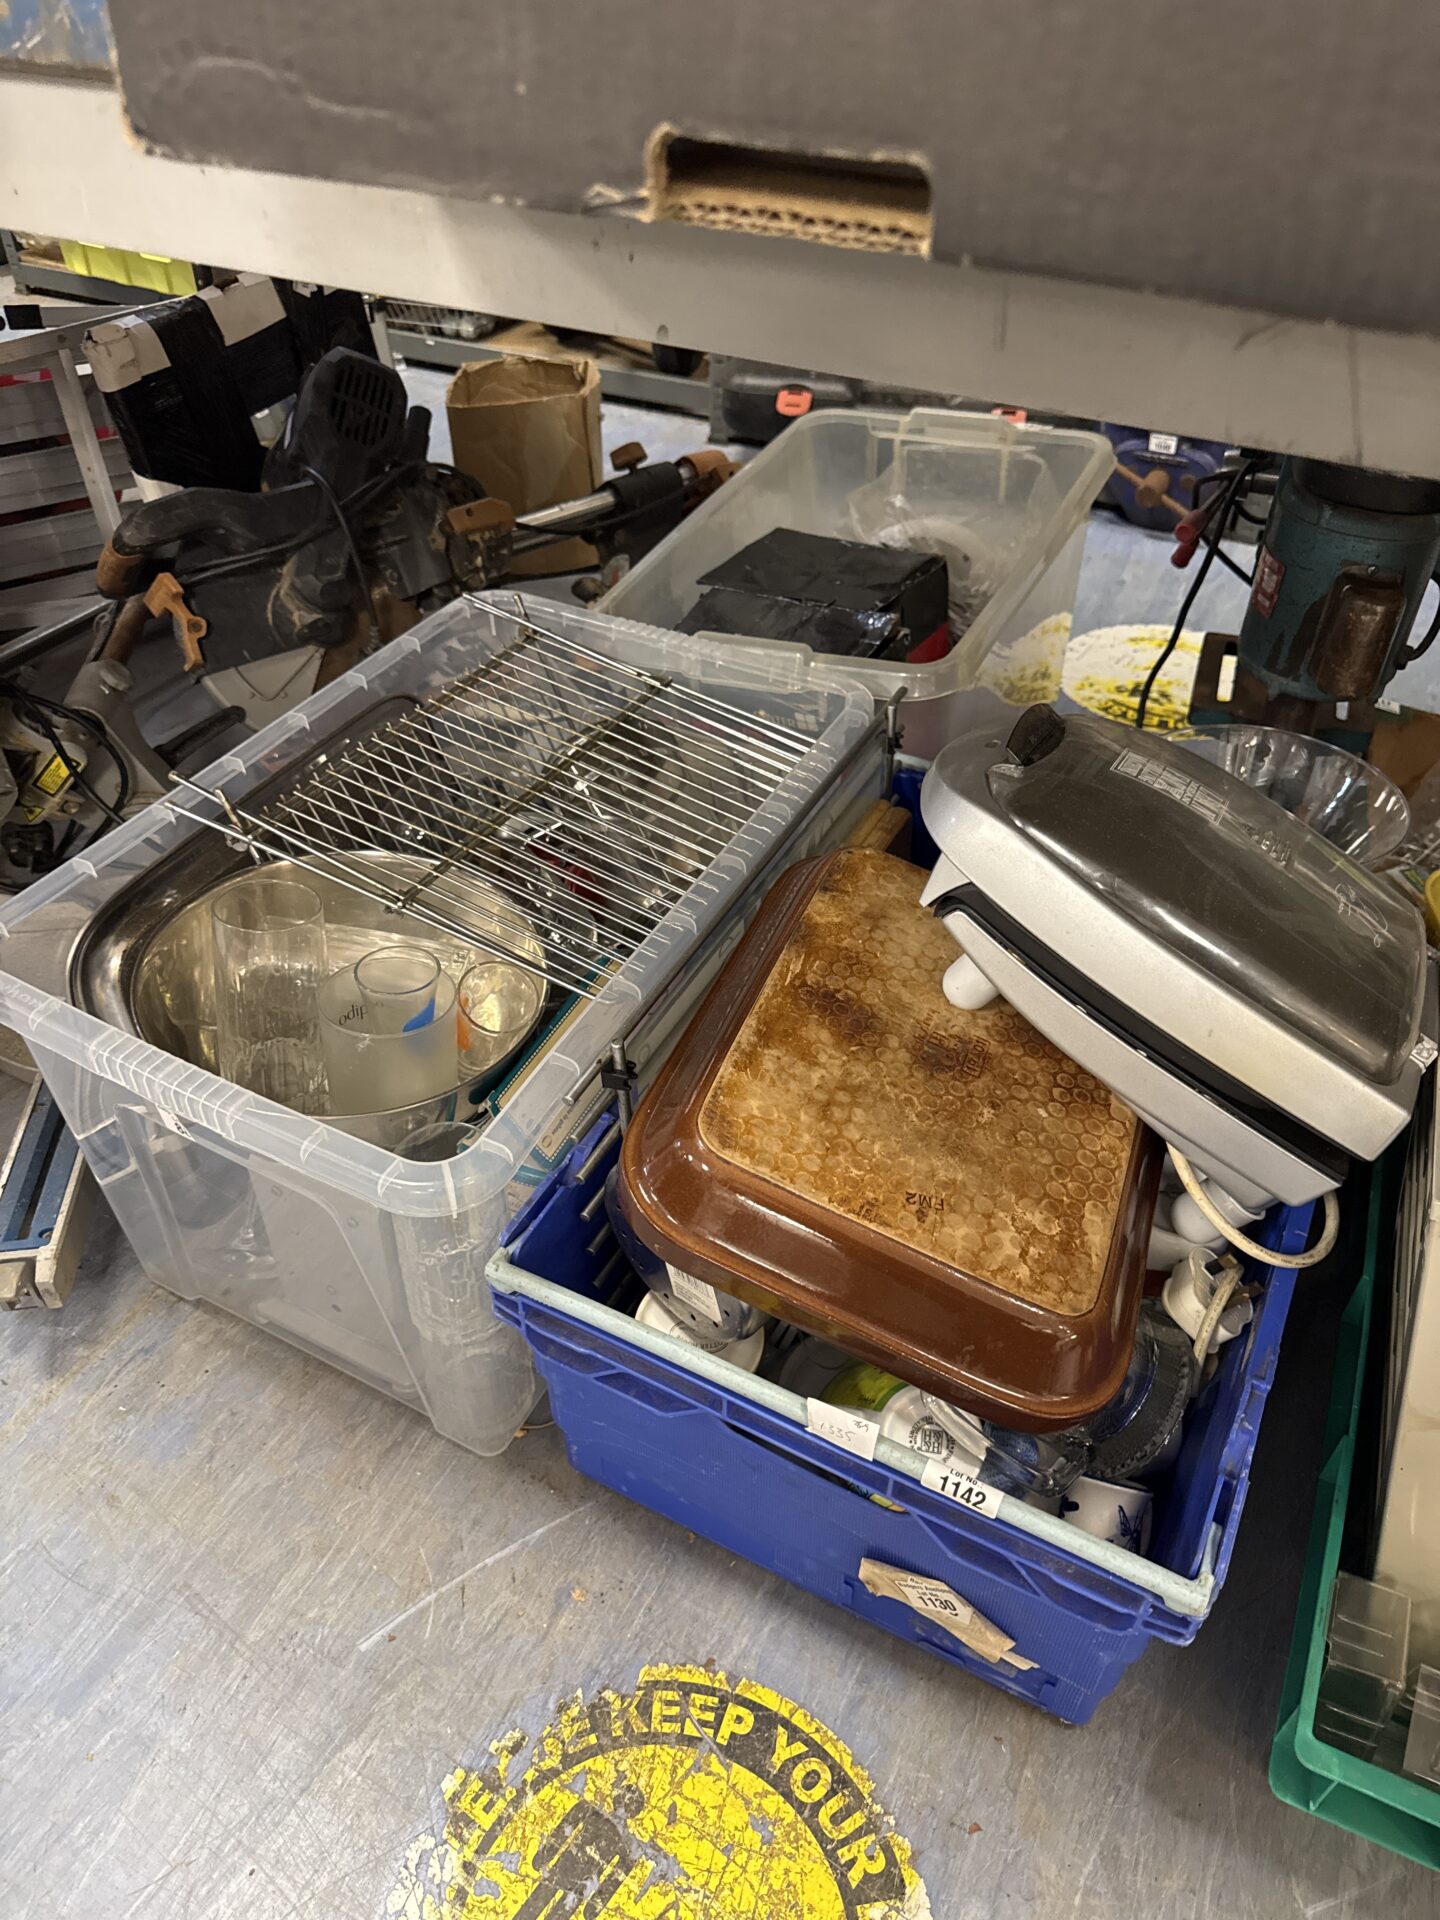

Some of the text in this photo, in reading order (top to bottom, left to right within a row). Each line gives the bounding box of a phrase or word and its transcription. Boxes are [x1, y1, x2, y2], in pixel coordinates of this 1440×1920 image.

[950, 1468, 964, 1479] Lot
[940, 1475, 986, 1511] 1142
[918, 1596, 957, 1612] 1130
[610, 1689, 755, 1746] KEEP
[770, 1724, 887, 1890] YOUR
